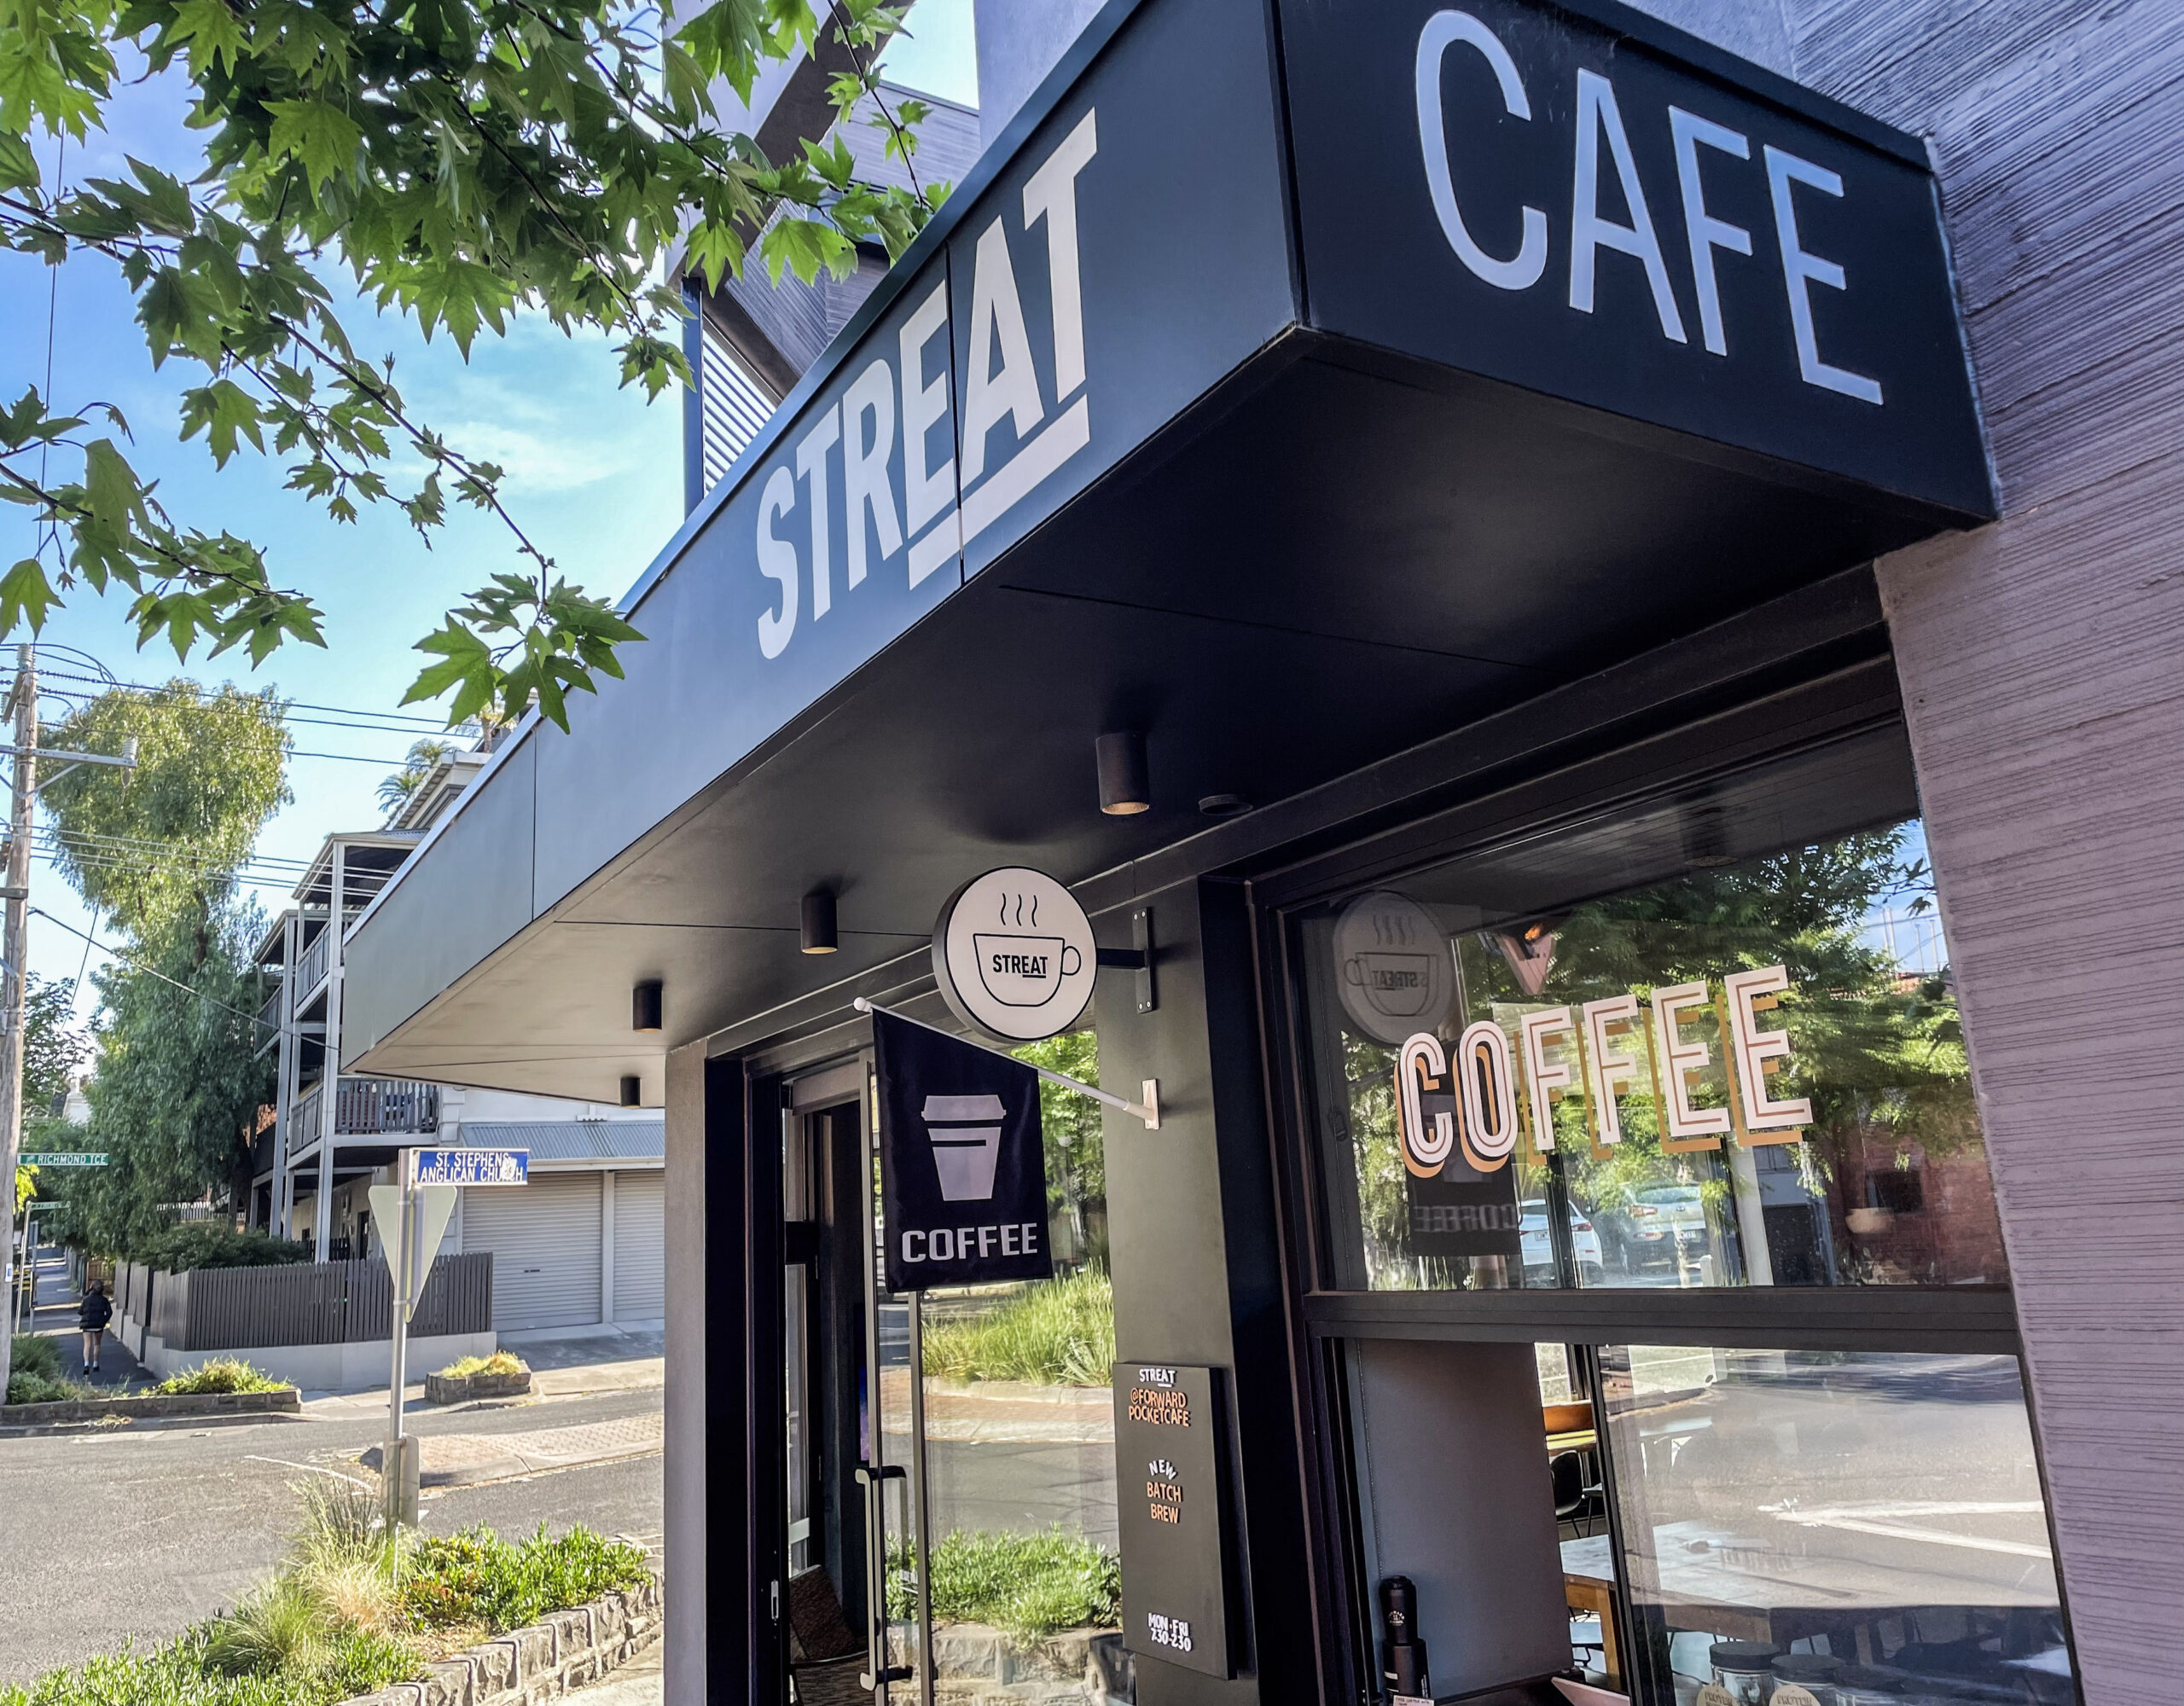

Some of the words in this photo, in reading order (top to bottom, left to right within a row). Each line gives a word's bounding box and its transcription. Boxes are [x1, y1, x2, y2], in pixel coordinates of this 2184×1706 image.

[1415, 9, 1884, 405] CAFE
[757, 107, 1097, 659] STREAT
[992, 954, 1048, 977] STREAT
[1395, 965, 1813, 1178] COFFEE
[38, 1155, 86, 1164] RICHMOND
[90, 1155, 107, 1164] TCE
[435, 1152, 450, 1167] ST.
[420, 1167, 475, 1182] ANGLICAN
[480, 1166, 523, 1182] CHUH
[901, 1222, 1038, 1263] COFFEE
[1139, 1368, 1176, 1384] STREAT
[1130, 1388, 1187, 1409] @FORWARD
[1149, 1459, 1177, 1480] NEW
[1147, 1482, 1182, 1503] BATCH
[1150, 1503, 1179, 1523] BREW
